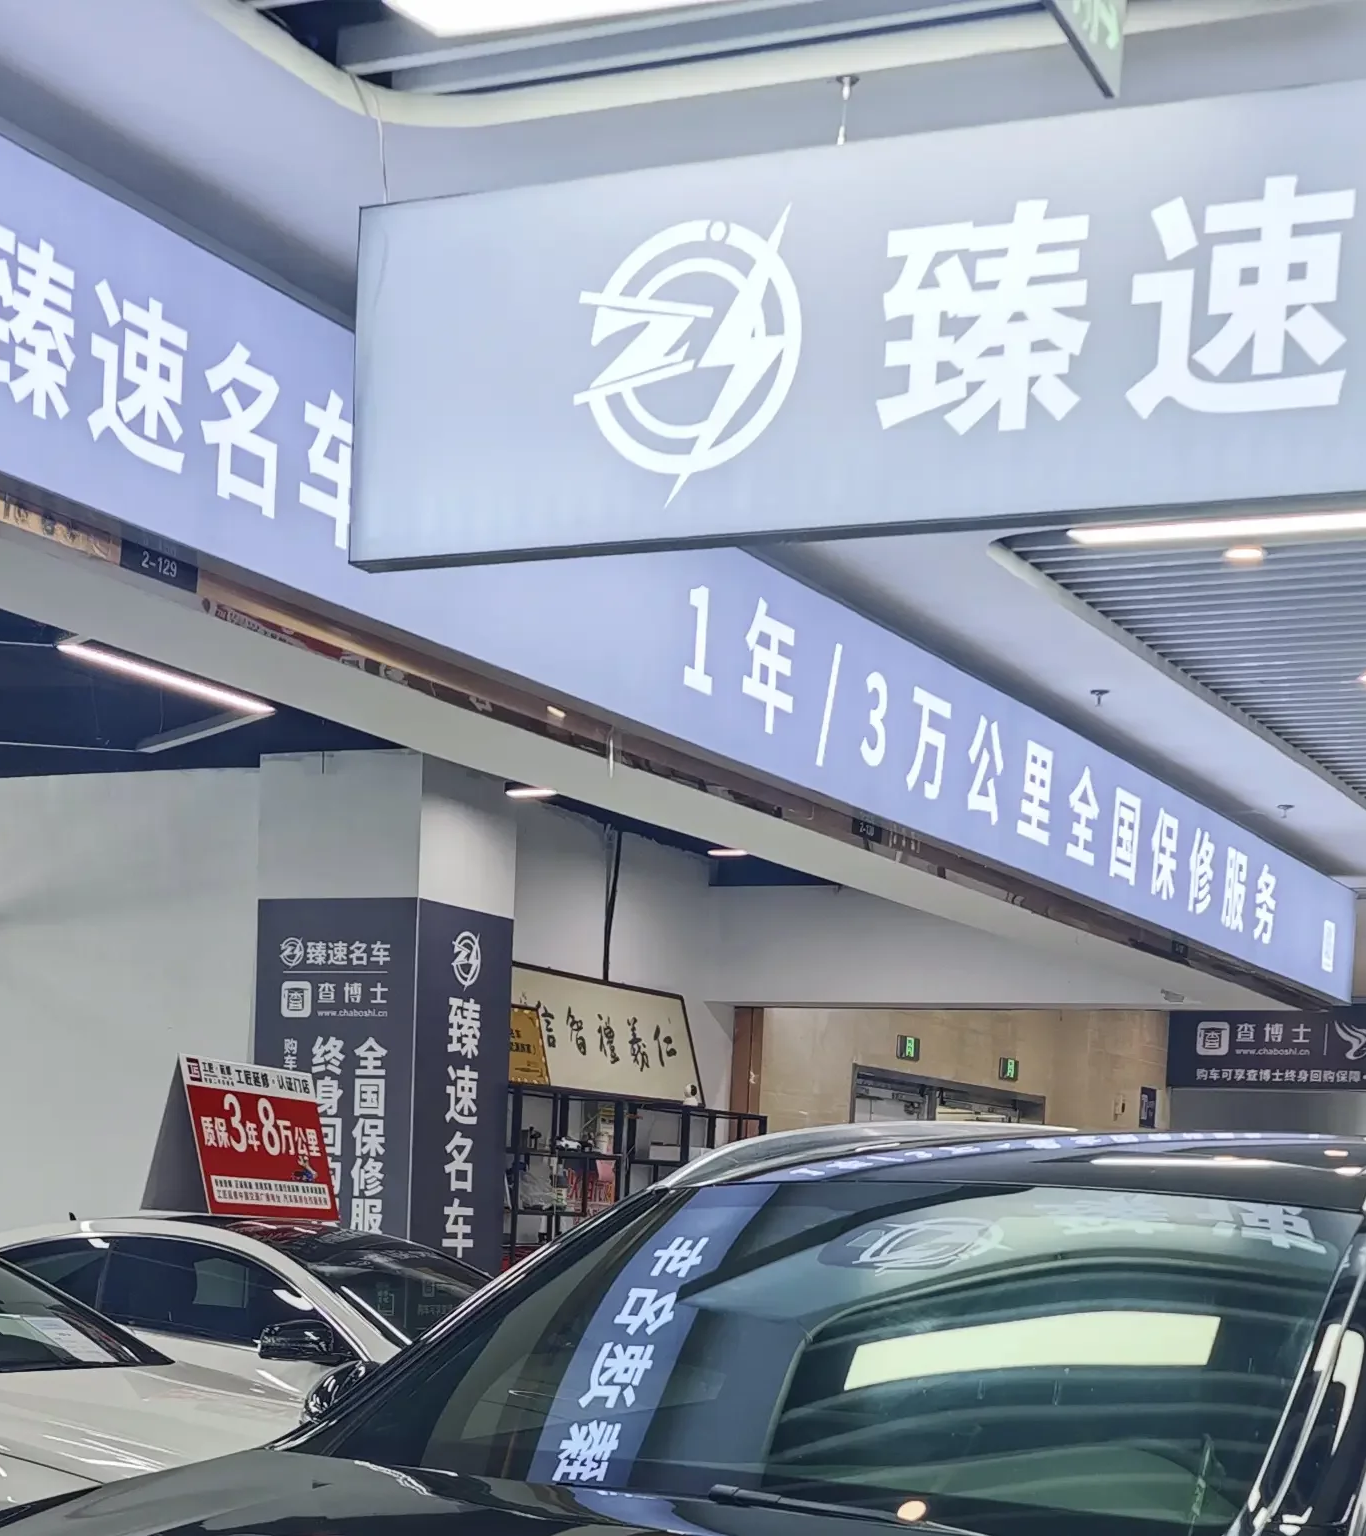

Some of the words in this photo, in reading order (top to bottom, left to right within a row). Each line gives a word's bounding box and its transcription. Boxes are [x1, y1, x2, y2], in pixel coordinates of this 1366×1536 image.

[141, 550, 178, 578] 2-129
[683, 584, 1276, 945] 1年/3万公里全国保修服务
[306, 941, 391, 965] 臻速名车
[317, 981, 389, 1004] 查博士
[316, 1008, 388, 1018] www.chaboshi.cn
[1235, 1022, 1312, 1044] 查博士
[1235, 1047, 1311, 1056] www.chaboshi.cn
[200, 1093, 322, 1157] 质保3年8万公里
[349, 1036, 388, 1235] 全国保修服
[441, 997, 482, 1259] 臻速名车
